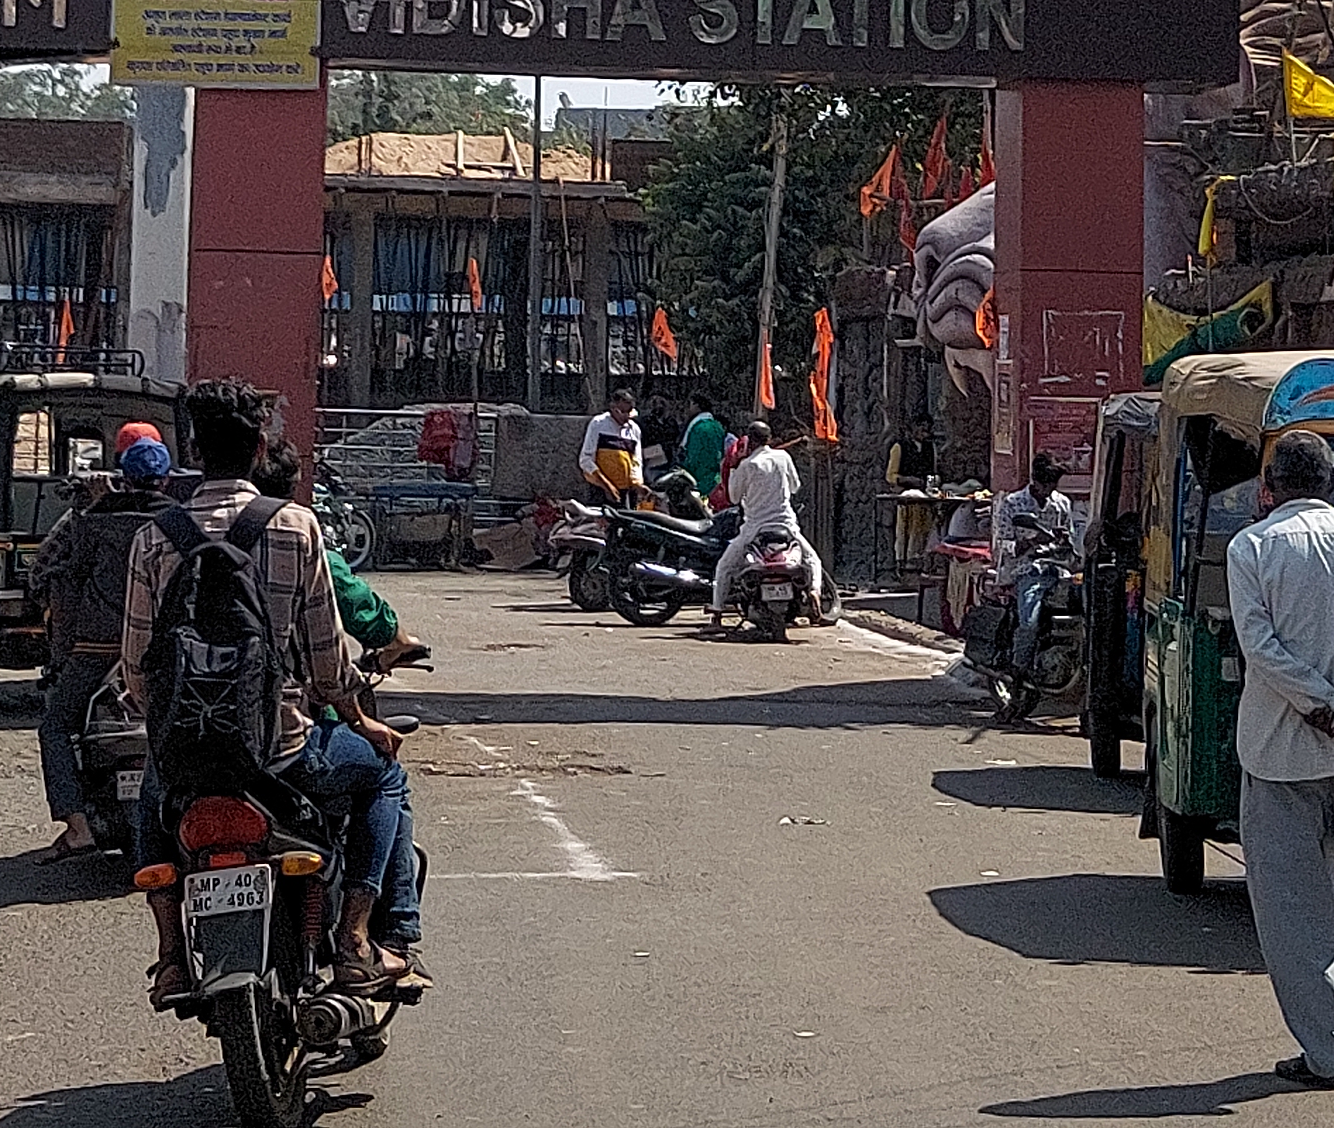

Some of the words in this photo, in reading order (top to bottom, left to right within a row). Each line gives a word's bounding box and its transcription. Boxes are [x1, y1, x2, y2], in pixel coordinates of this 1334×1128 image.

[199, 877, 220, 892] MP
[235, 873, 252, 887] 40
[192, 896, 212, 912] MC
